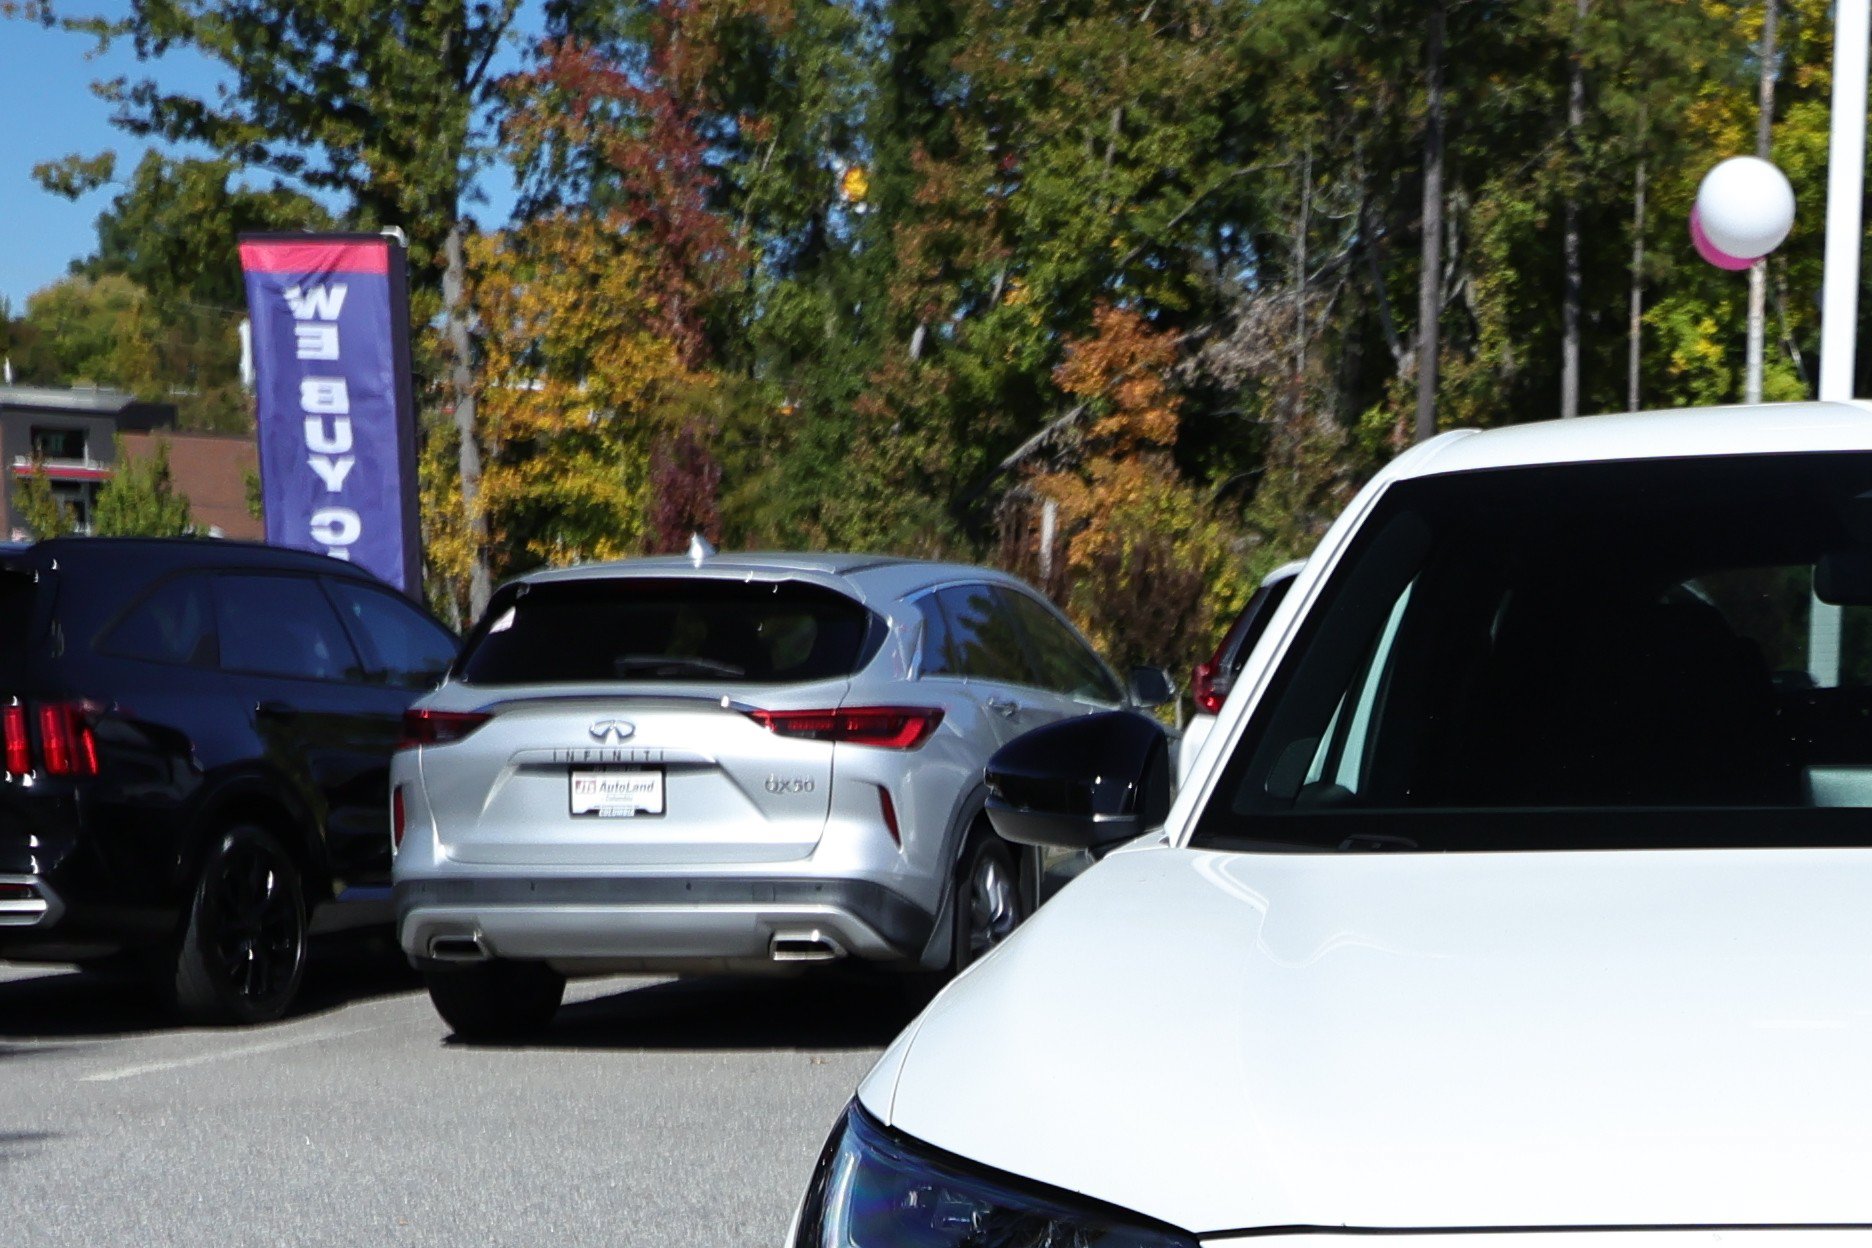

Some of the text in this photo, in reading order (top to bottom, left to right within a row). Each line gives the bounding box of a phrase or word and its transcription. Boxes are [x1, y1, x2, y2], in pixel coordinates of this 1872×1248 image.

[553, 750, 664, 763] INFINITI
[599, 779, 655, 793] AutoLand
[764, 774, 815, 794] QX50
